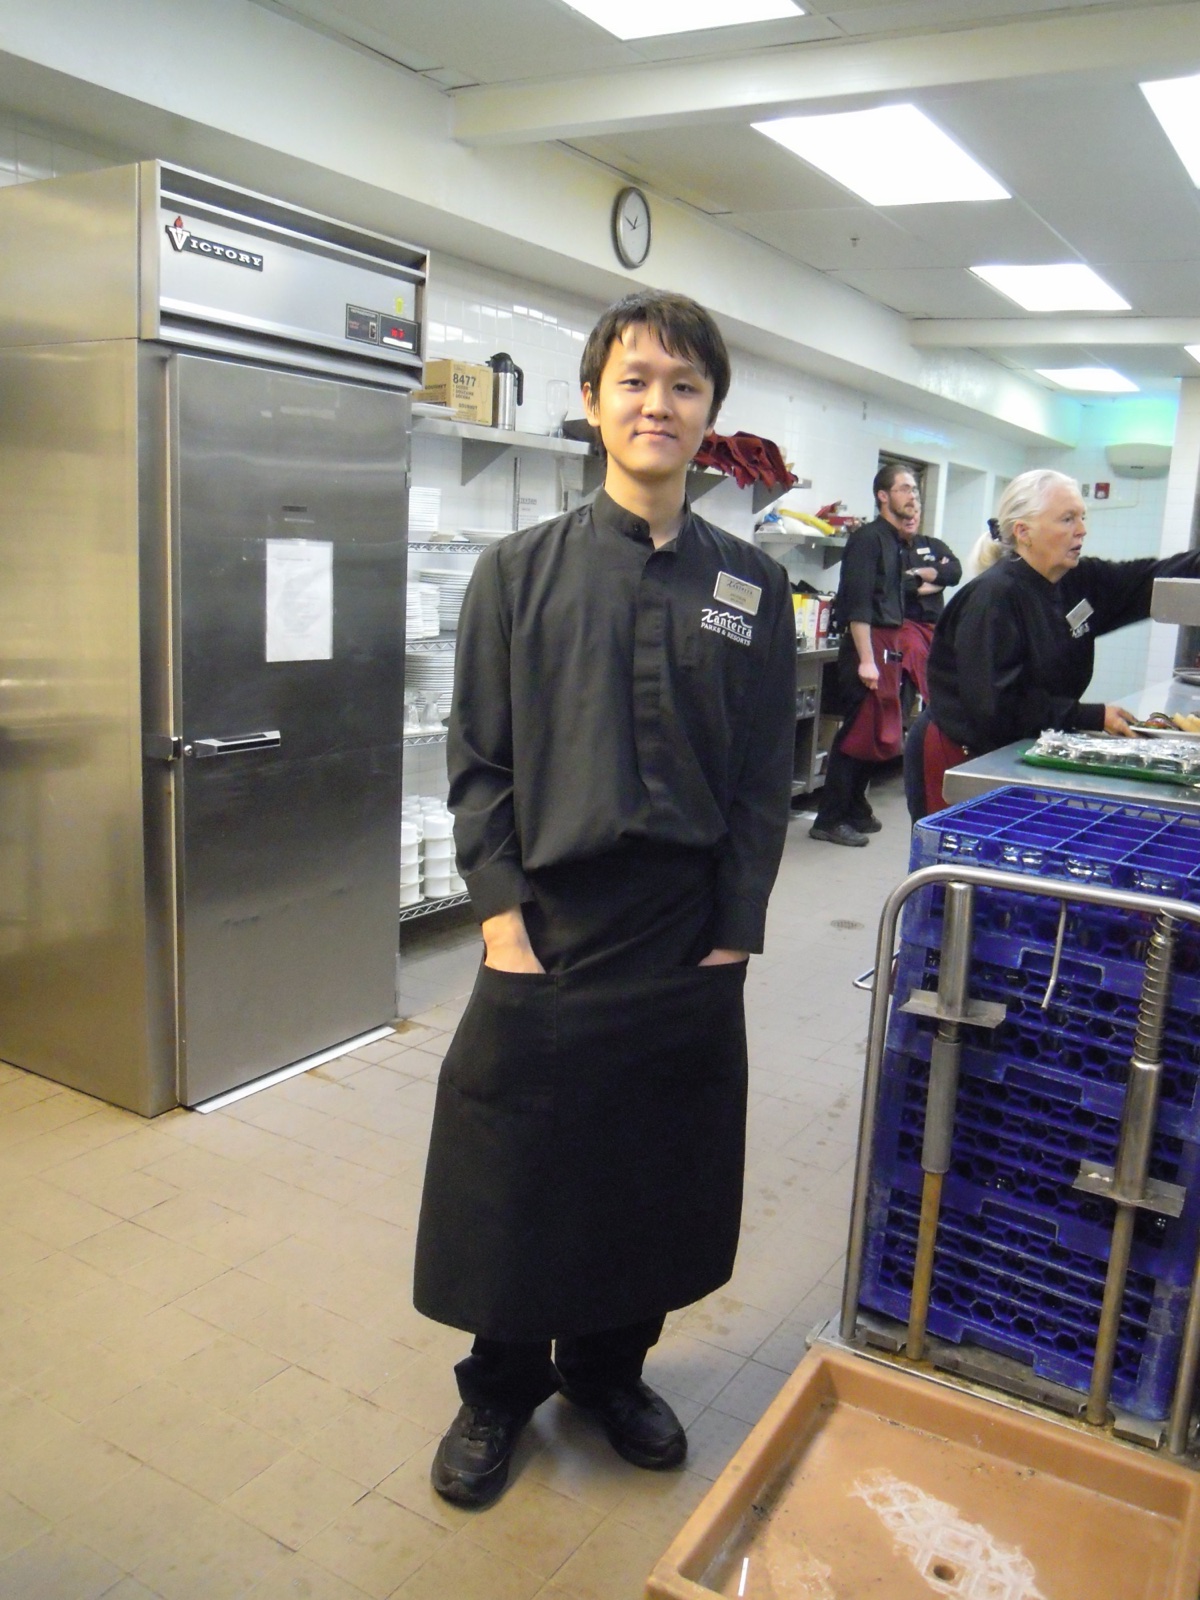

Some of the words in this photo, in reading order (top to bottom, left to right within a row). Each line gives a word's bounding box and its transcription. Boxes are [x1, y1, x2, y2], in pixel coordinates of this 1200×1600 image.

[168, 227, 262, 266] VICTORY
[453, 373, 476, 387] 8477
[700, 622, 721, 634] PARKS
[726, 631, 752, 646] RESORTS
[701, 608, 752, 638] Xanterra
